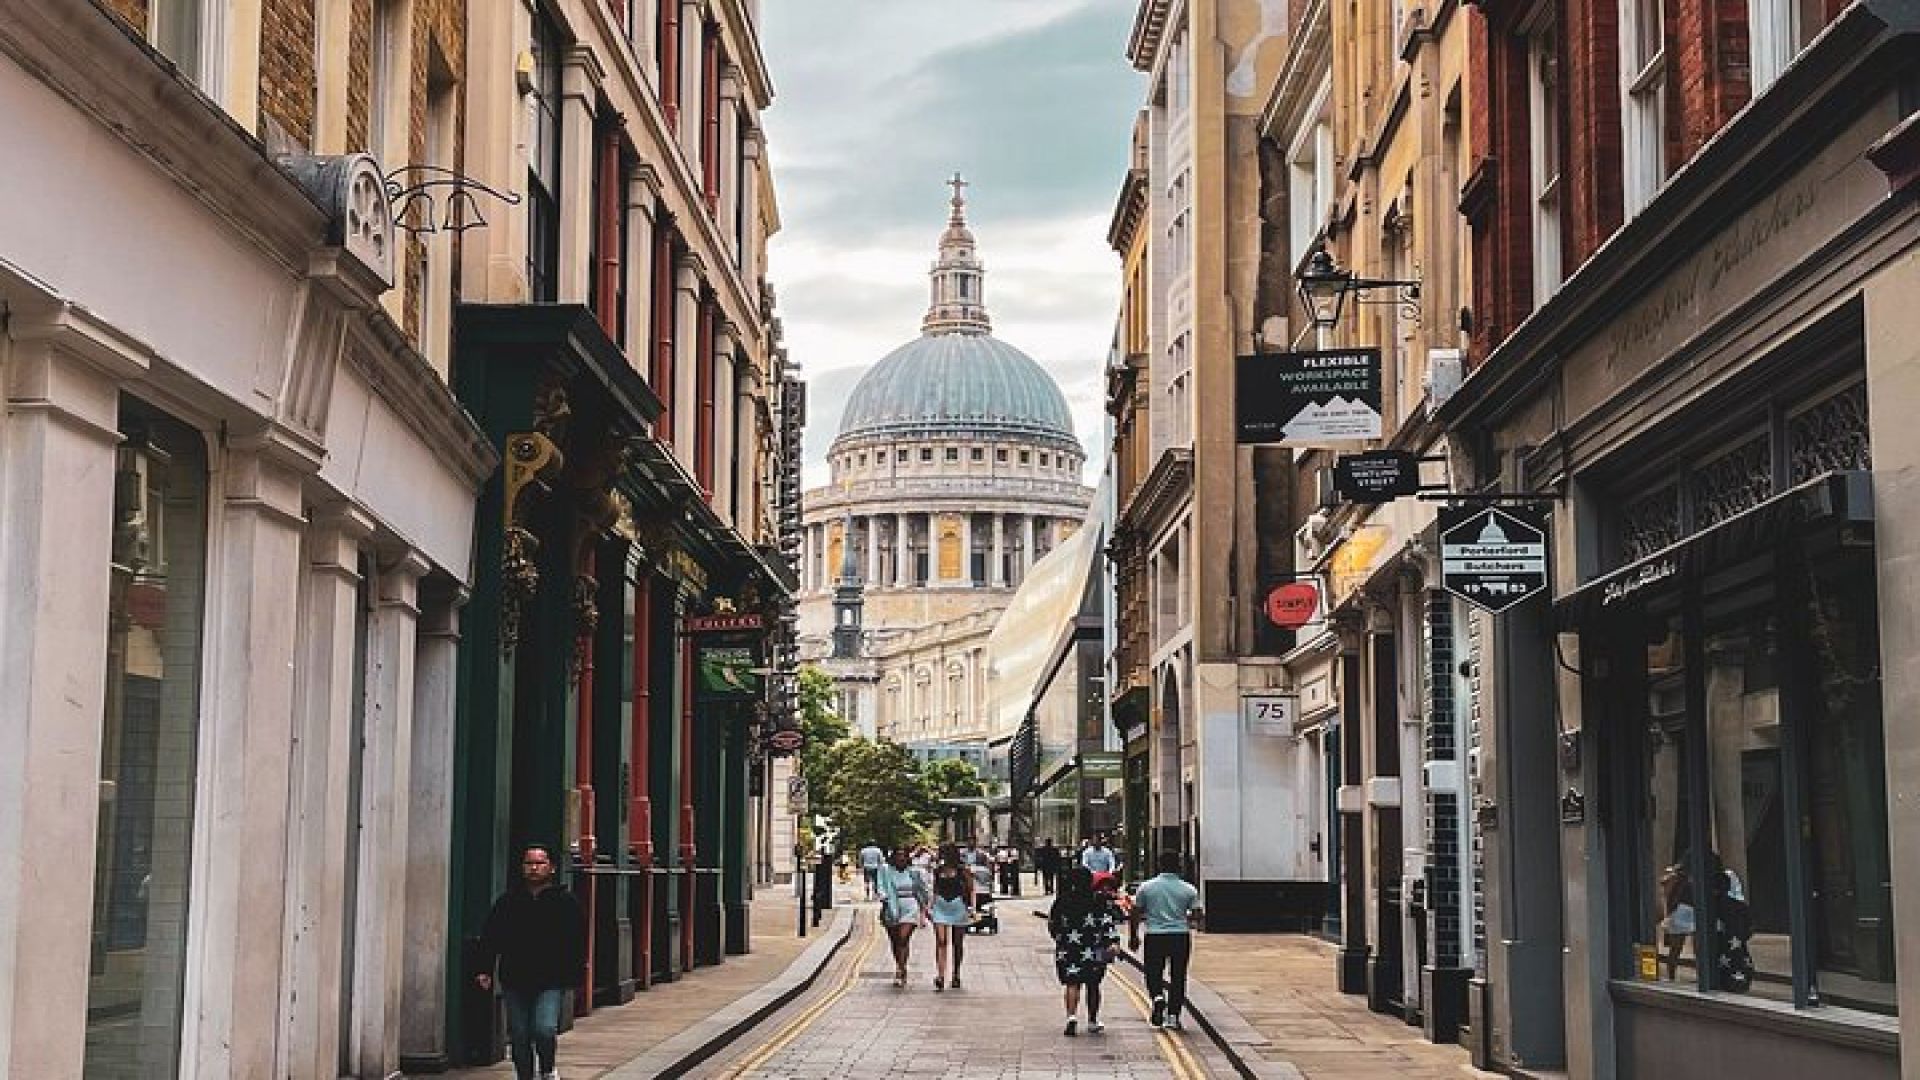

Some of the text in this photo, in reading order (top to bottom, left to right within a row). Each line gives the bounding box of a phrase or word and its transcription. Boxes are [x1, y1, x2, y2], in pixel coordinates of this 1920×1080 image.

[1303, 355, 1369, 368] FLEXIBLE
[1279, 368, 1369, 381] WORKSPACE
[1290, 380, 1369, 394] AVAILABLE
[1461, 546, 1528, 554] Porterford
[1464, 562, 1524, 570] Butchers
[1255, 703, 1284, 719] 75
